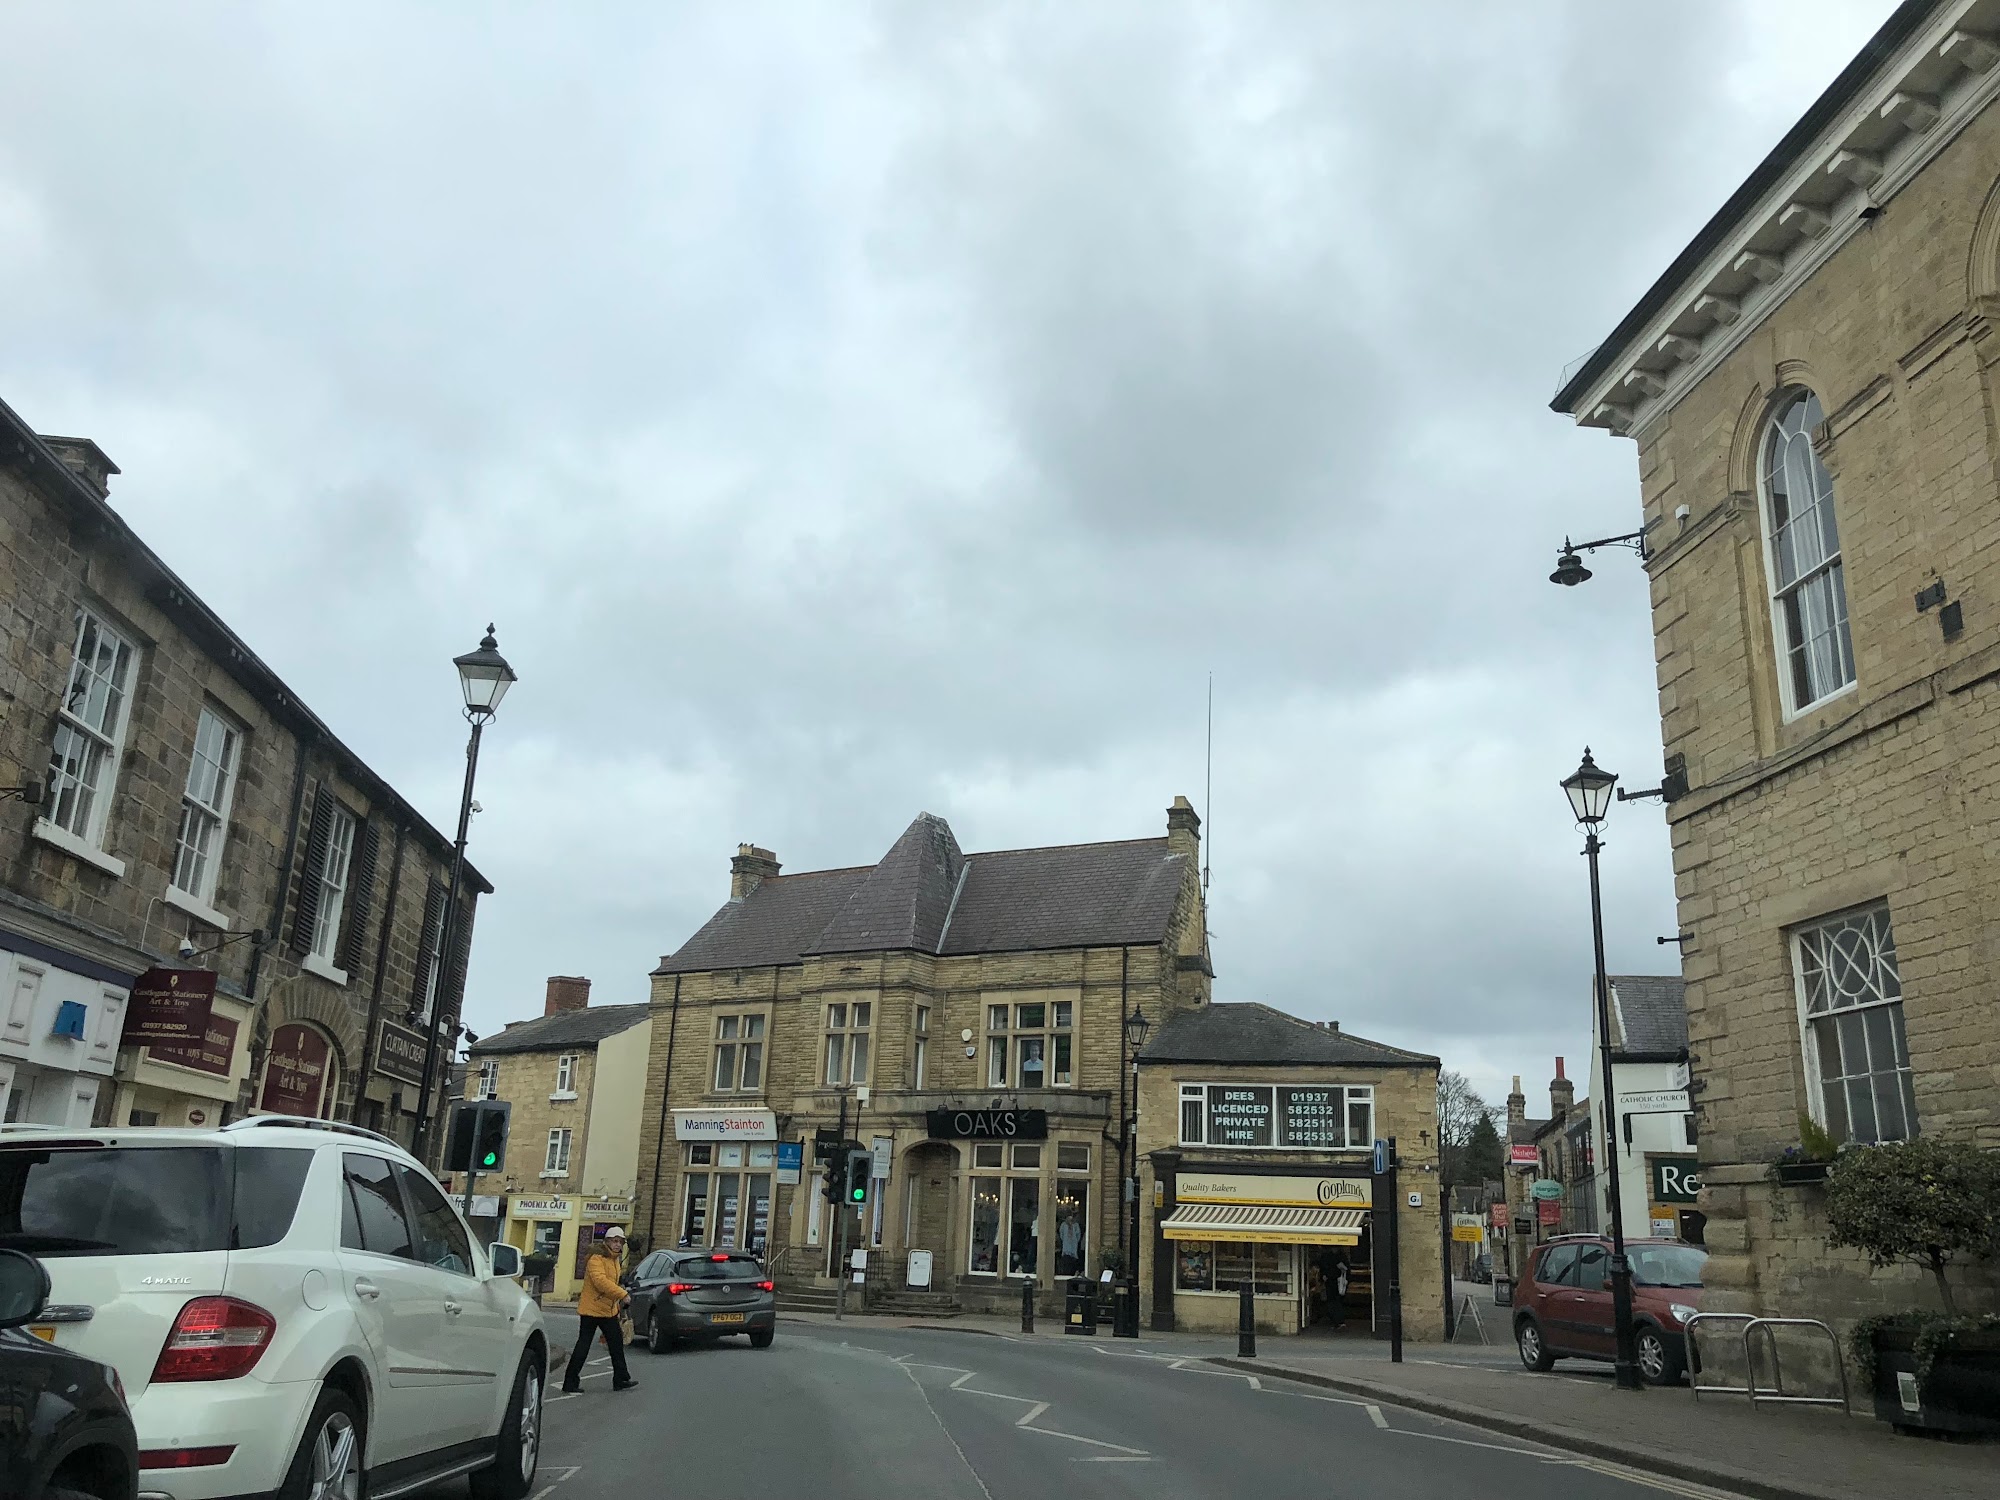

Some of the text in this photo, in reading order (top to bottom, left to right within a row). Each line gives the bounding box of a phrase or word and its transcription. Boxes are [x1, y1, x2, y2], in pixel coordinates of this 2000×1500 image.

[134, 988, 208, 1001] Castlegate Stationery
[149, 998, 161, 1006] Art
[173, 999, 189, 1008] Toys
[385, 1033, 410, 1057] CURTAIN
[1225, 1091, 1255, 1101] DEES
[1290, 1092, 1329, 1102] 01937
[1620, 1094, 1686, 1104] CATHOLIC CHURCH
[1211, 1104, 1269, 1114] LICENCED
[1287, 1105, 1334, 1115] 582532
[954, 1112, 1017, 1136] OAKS
[1215, 1117, 1265, 1127] PRIVATE
[1288, 1118, 1334, 1128] 582511
[1226, 1130, 1254, 1140] HIRE
[1288, 1131, 1334, 1141] 582533
[1182, 1182, 1238, 1194] Quality Bakers
[1317, 1180, 1365, 1206] Cooplands
[519, 1200, 567, 1210] PHOENIX CAFE
[585, 1202, 629, 1212] PHOENIX CAFE
